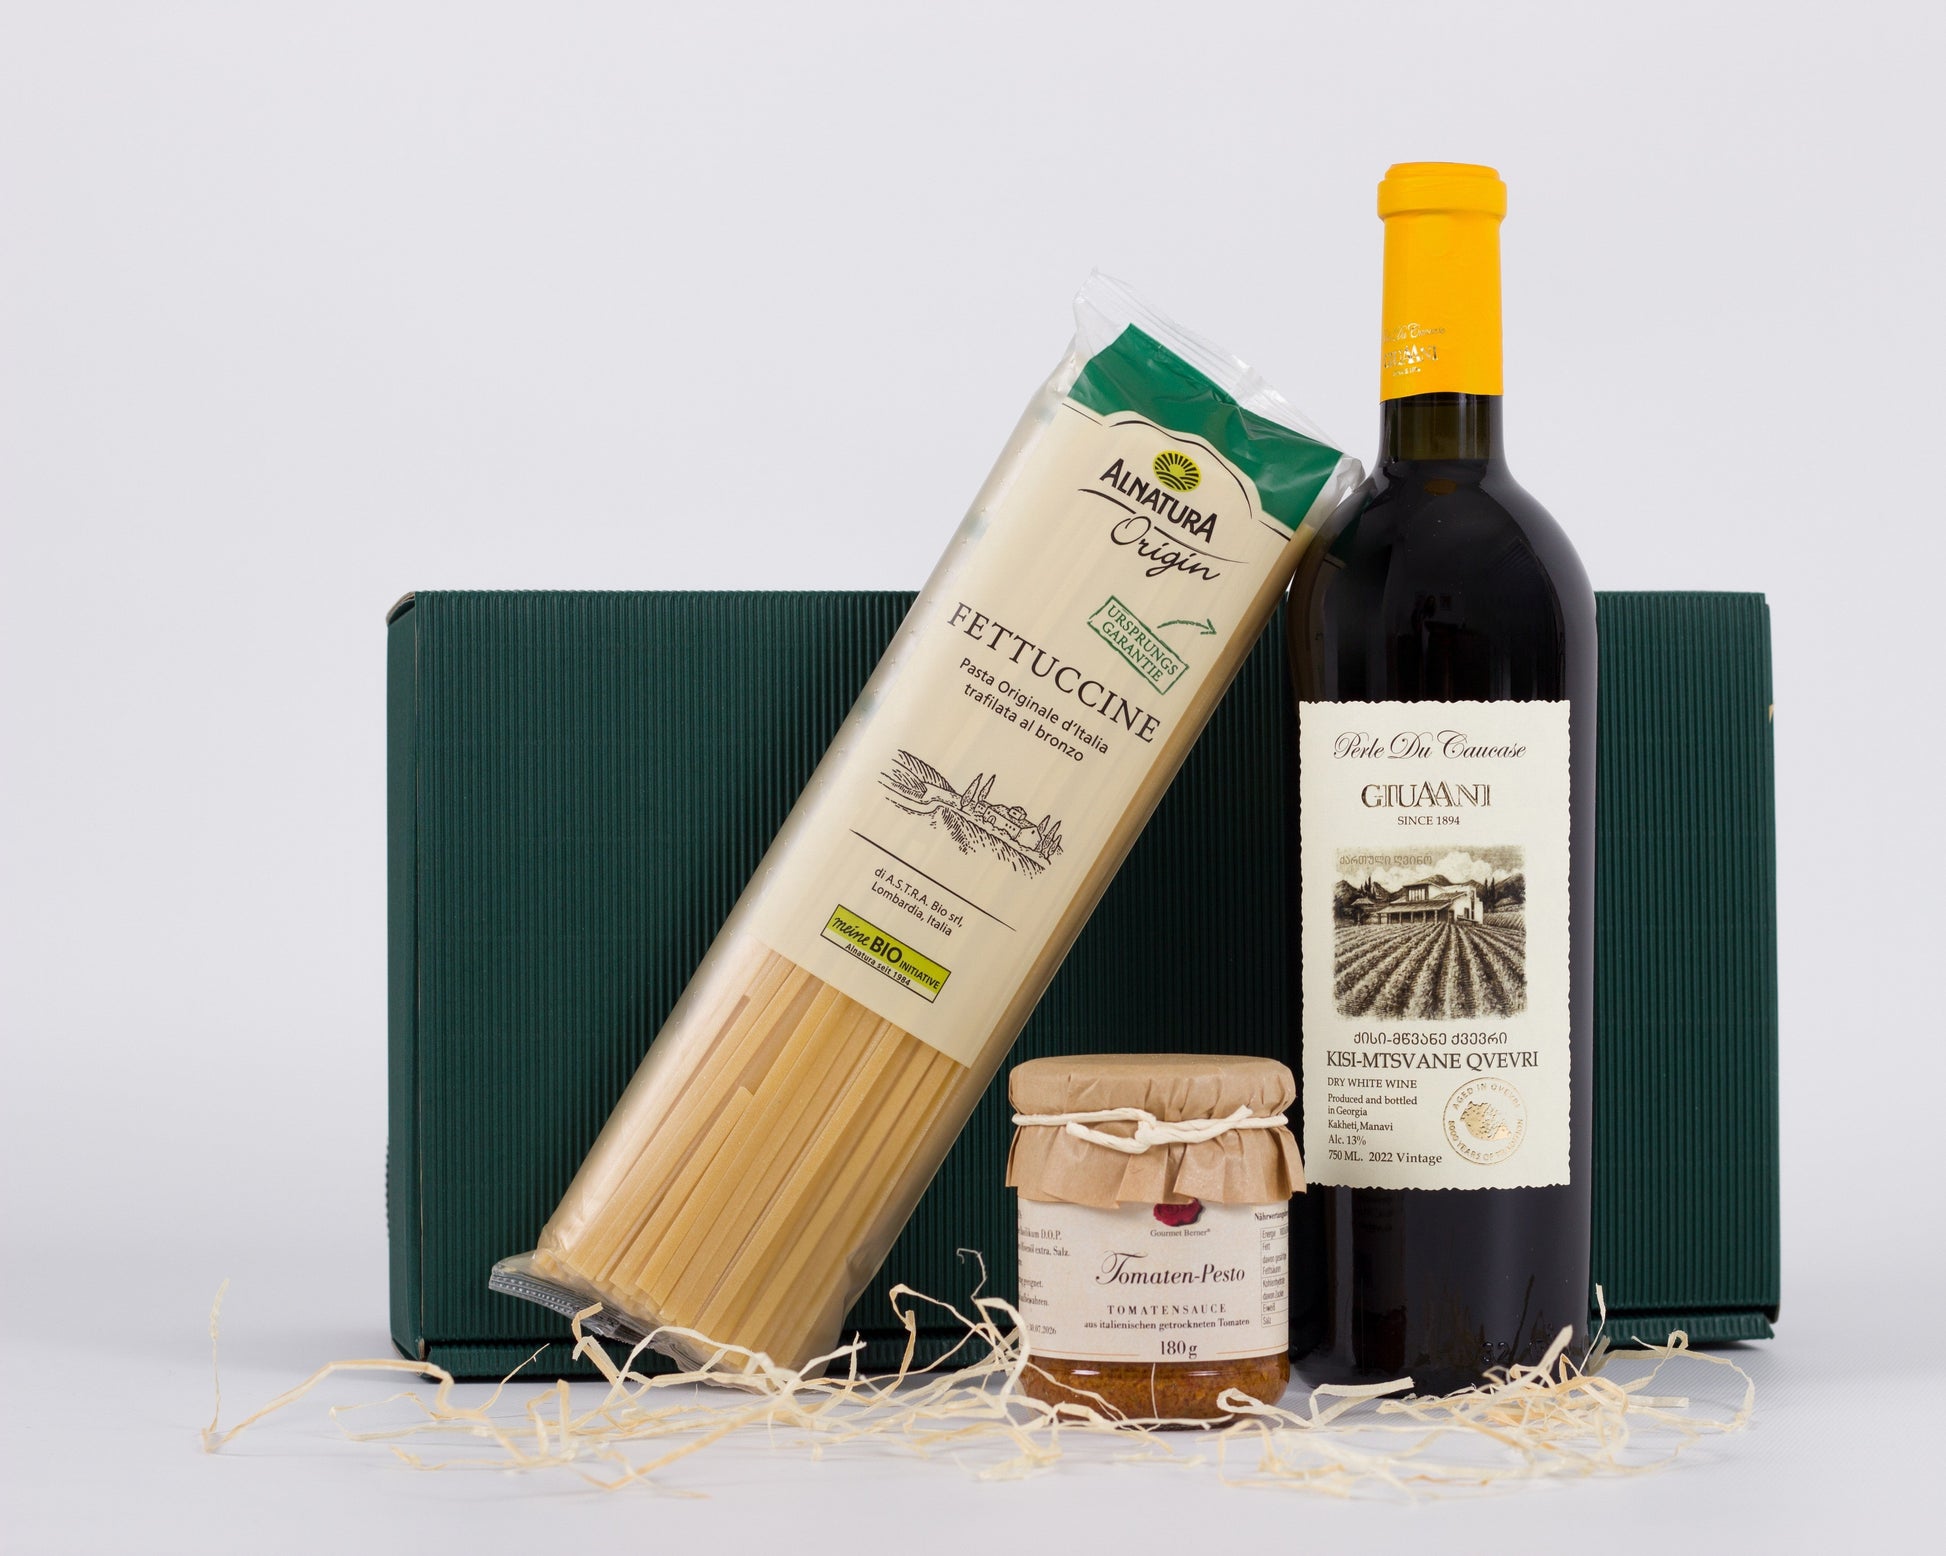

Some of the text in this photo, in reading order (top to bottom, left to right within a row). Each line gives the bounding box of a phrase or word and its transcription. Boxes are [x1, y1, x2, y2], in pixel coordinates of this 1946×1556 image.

[1099, 458, 1218, 543] ALNATURA
[1110, 516, 1220, 580] Origin
[1102, 621, 1164, 682] GARANTIE
[1107, 605, 1178, 676] URSPRUNGS
[947, 602, 1160, 743] FETTUCCINE
[959, 657, 995, 686] Pasta
[998, 680, 1059, 724] Originale
[964, 682, 1084, 762] trafilata al bronzo
[1333, 729, 1526, 759] Perle Du Caucase
[1361, 780, 1491, 808] GIUAANI
[1397, 816, 1460, 826] SINCE 1894
[1339, 855, 1433, 866] ქართული ღვინო
[871, 881, 952, 936] Lombardia, Italia
[874, 867, 964, 928] di A.S.T.R.A. Bio srl,
[833, 916, 940, 990] meine BIO INITIATIVE
[845, 943, 911, 986] Alnatura seit 1984
[1353, 1031, 1508, 1045] ქისი-მწვანე ქვევრი
[1326, 1050, 1539, 1072] KISI-MTSVANE QVEVRI
[1327, 1077, 1418, 1089] DRY WHITE WINE
[1327, 1093, 1418, 1105] Produced and bottled
[1327, 1106, 1368, 1119] in Georgia
[1327, 1134, 1367, 1146] Alc. 13%
[1360, 1121, 1393, 1132] Manavi
[1328, 1150, 1443, 1166] 750 ML. 2022 Vintage
[1150, 1229, 1181, 1238] Gourmet
[1096, 1250, 1246, 1285] Tomaten-Pesto
[1107, 1303, 1227, 1315] TOMATENSAUCE
[1084, 1317, 1250, 1331] aus italienischen getrockneten Tomaten
